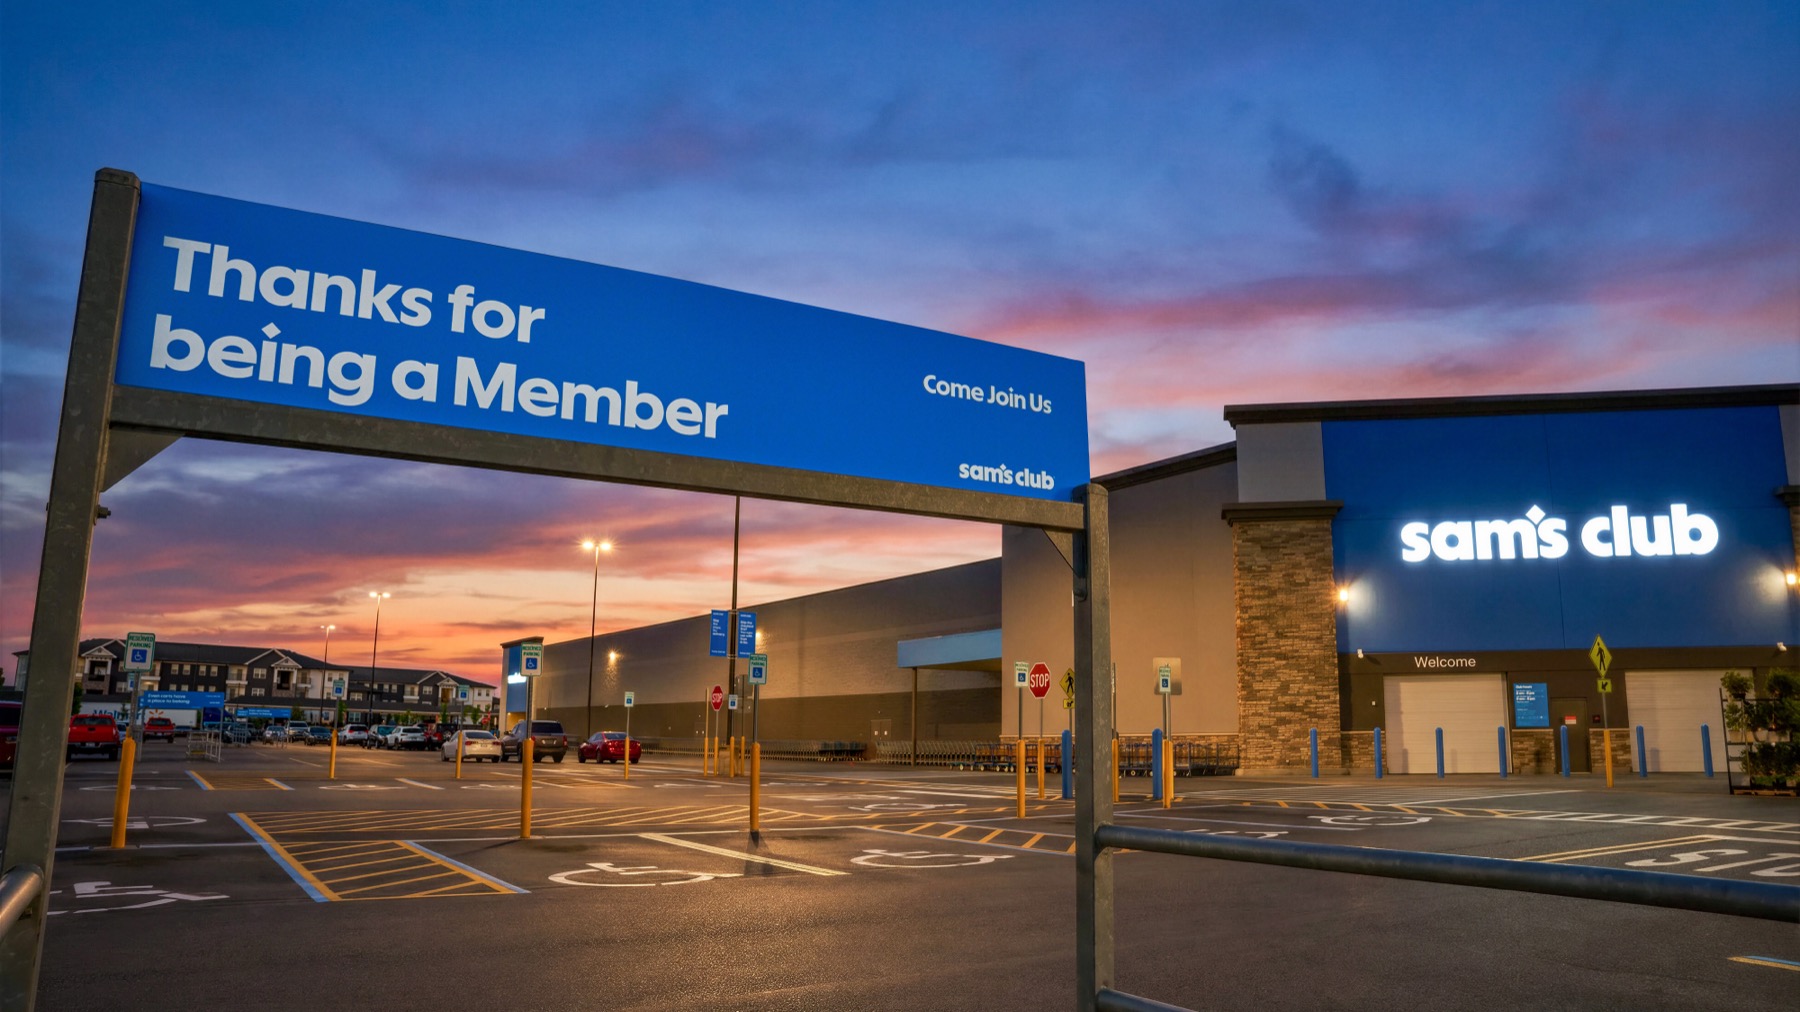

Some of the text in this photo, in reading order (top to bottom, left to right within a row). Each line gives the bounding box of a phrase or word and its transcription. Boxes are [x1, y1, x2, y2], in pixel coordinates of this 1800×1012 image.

[163, 236, 546, 343] Thanks for
[149, 313, 729, 439] being a Member
[923, 374, 1052, 414] Come Join Us
[1015, 468, 1055, 490] club
[1581, 503, 1719, 557] club
[1414, 656, 1476, 668] Welcome
[1030, 673, 1050, 688] STOP
[712, 692, 722, 703] STOP
